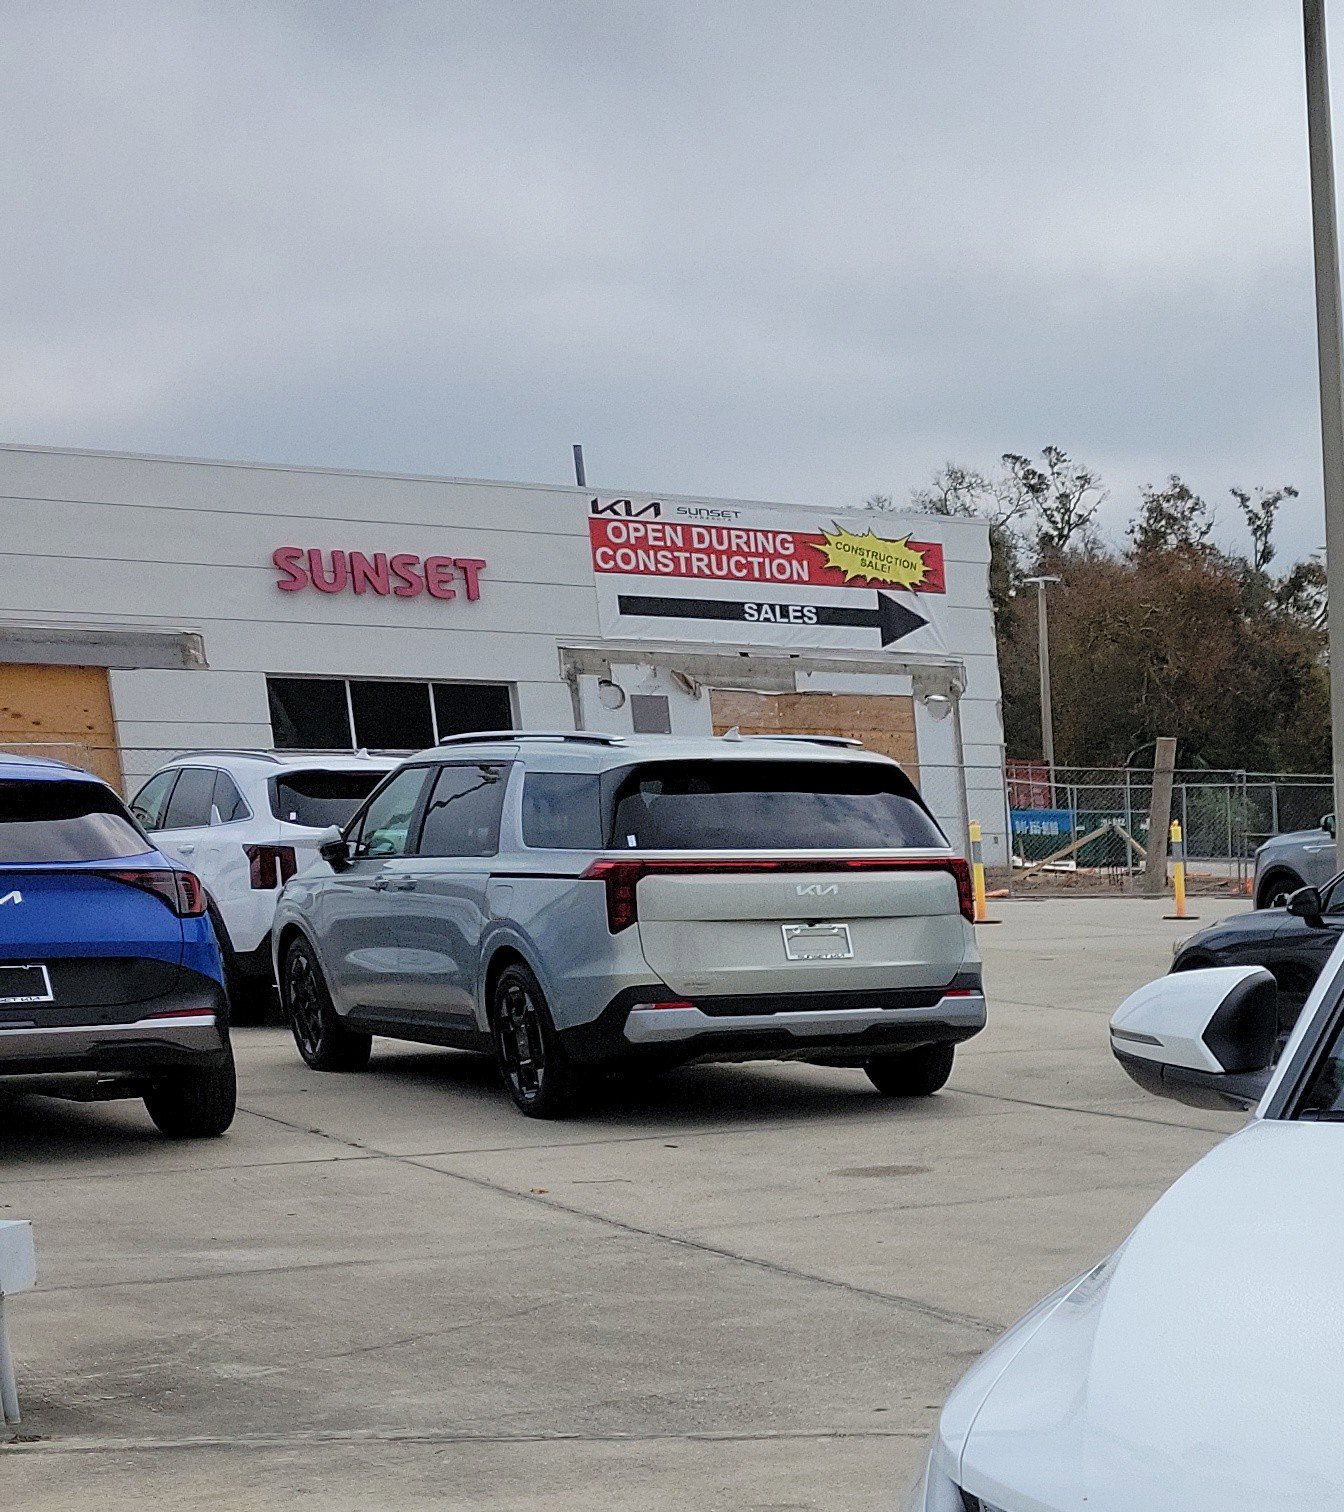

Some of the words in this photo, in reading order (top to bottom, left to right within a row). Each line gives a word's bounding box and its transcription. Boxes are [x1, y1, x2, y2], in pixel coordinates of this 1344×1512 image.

[591, 498, 661, 518] KIA
[676, 506, 741, 518] SUNSET
[606, 521, 684, 547] OPEN
[692, 527, 795, 555] DURING
[595, 546, 810, 581] CONSTRUCTION
[835, 541, 917, 571] CONSTRUCTION
[860, 558, 891, 573] SALE!
[272, 546, 486, 600] SUNSET
[744, 602, 818, 624] SALES
[796, 884, 838, 896] KIA
